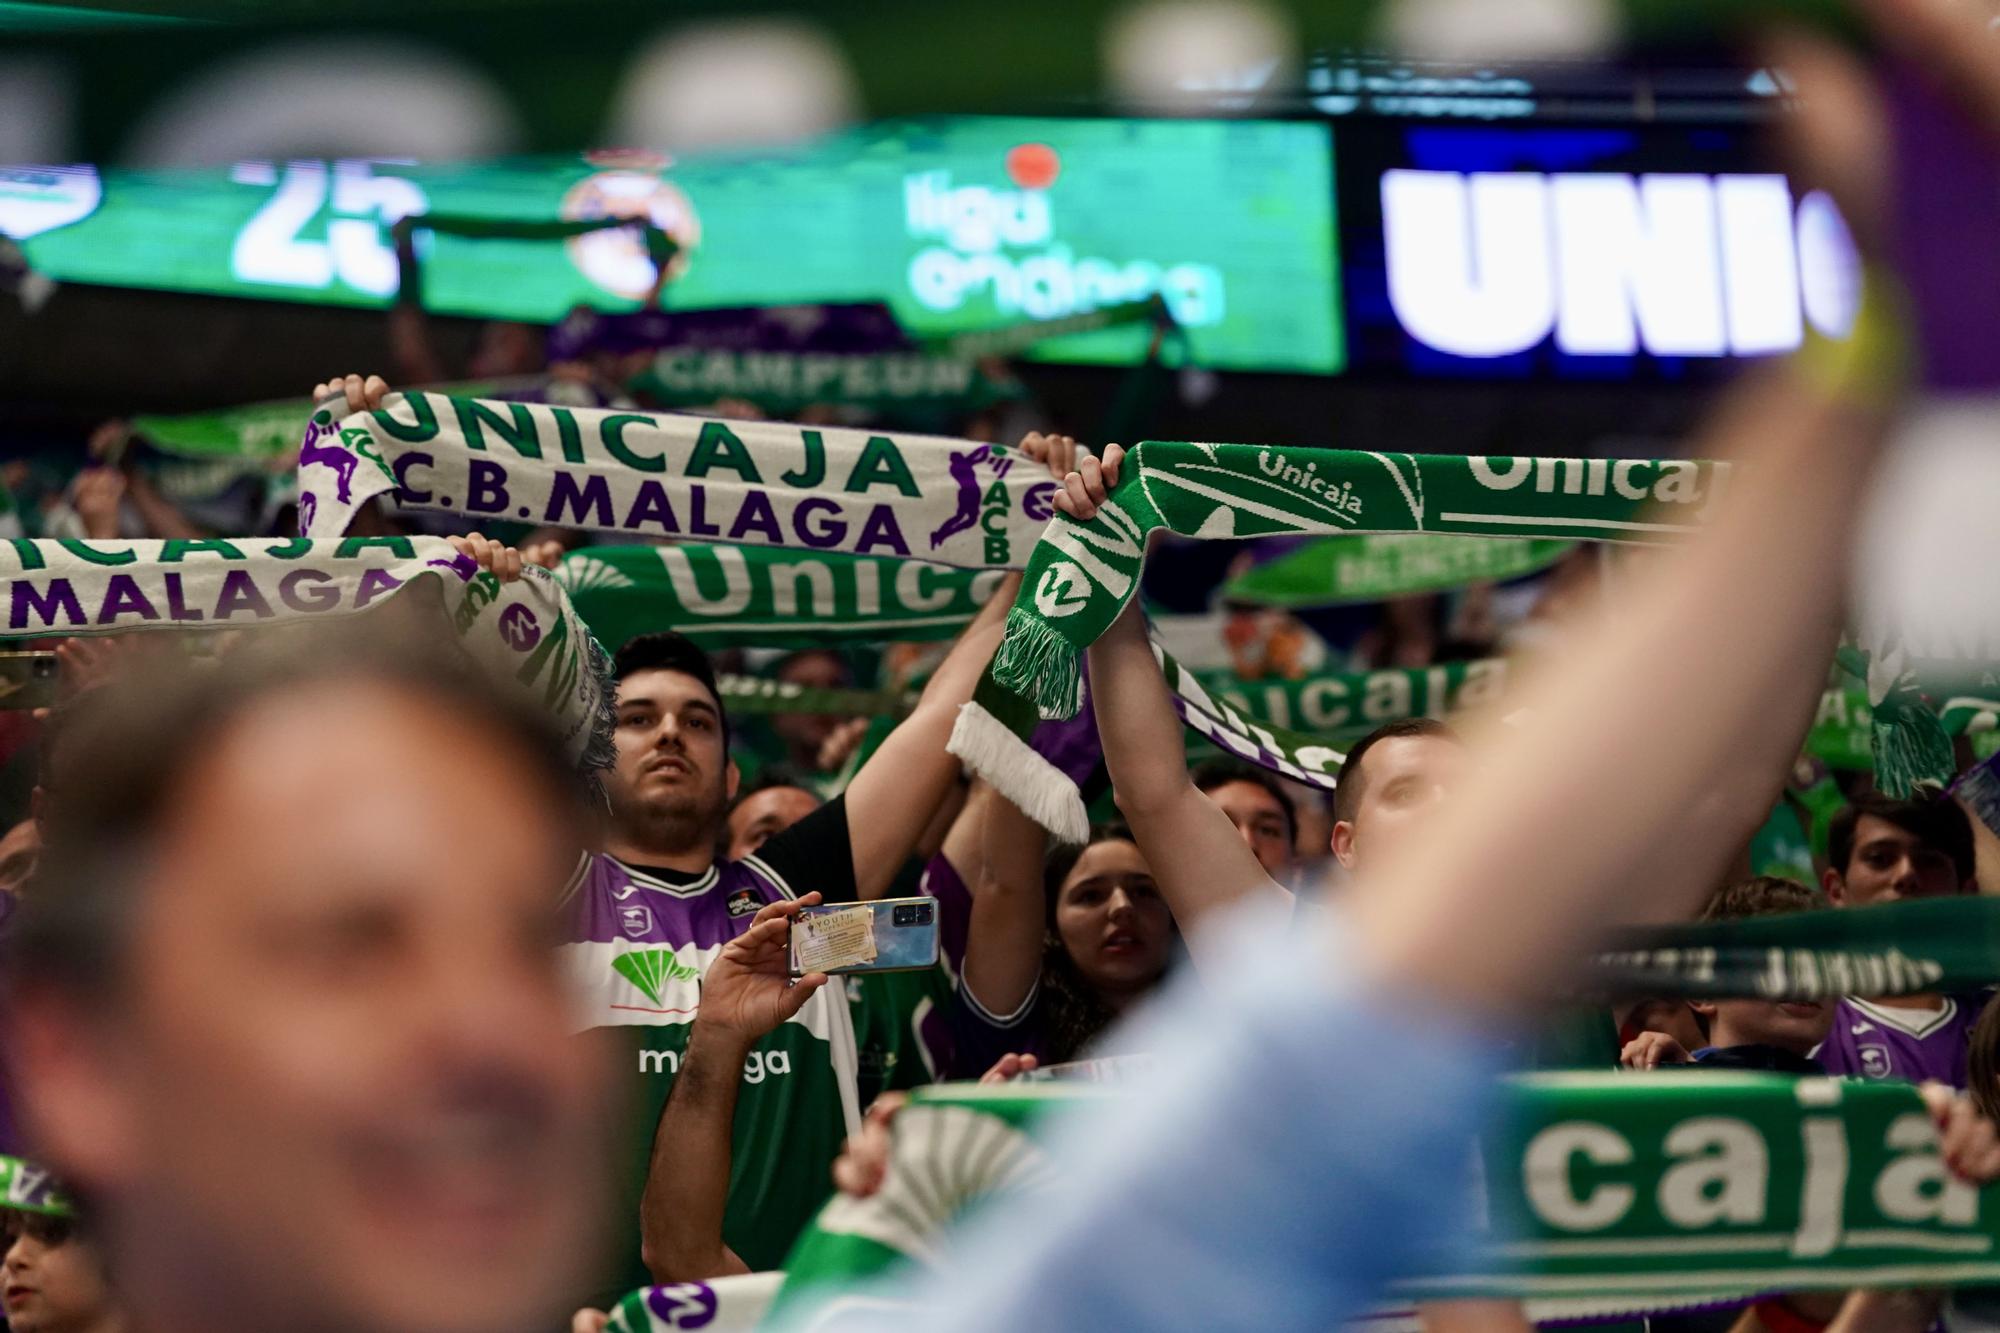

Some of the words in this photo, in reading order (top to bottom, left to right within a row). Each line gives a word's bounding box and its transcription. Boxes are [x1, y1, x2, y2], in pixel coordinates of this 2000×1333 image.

[371, 390, 922, 498] UNICAJA
[1258, 451, 1364, 515] Unicaja
[9, 568, 405, 629] MALAGA
[816, 912, 853, 928] YOUTH
[1523, 1076, 1981, 1258] caja
